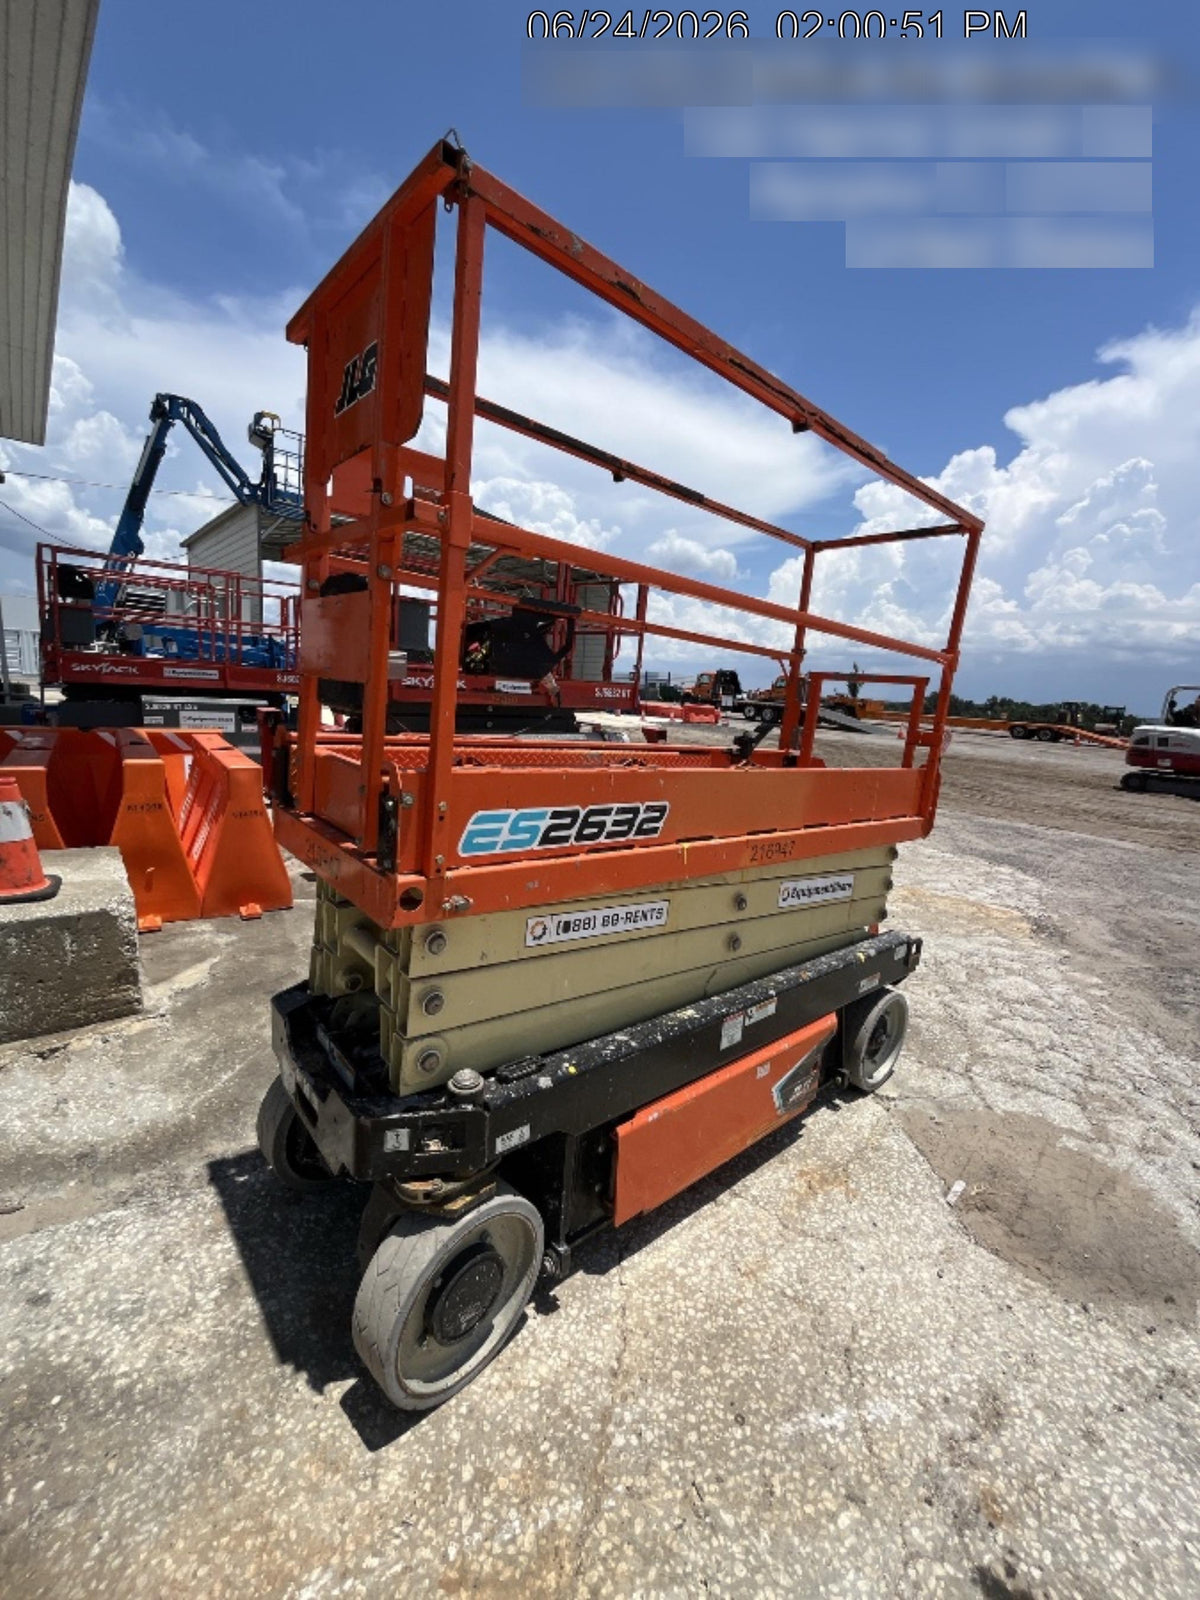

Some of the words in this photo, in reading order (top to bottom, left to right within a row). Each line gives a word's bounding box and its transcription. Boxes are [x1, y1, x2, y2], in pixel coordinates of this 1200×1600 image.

[334, 340, 378, 417] JLG
[71, 661, 140, 675] SKYJACK
[401, 675, 467, 689] SKYK
[459, 803, 669, 855] ES2632
